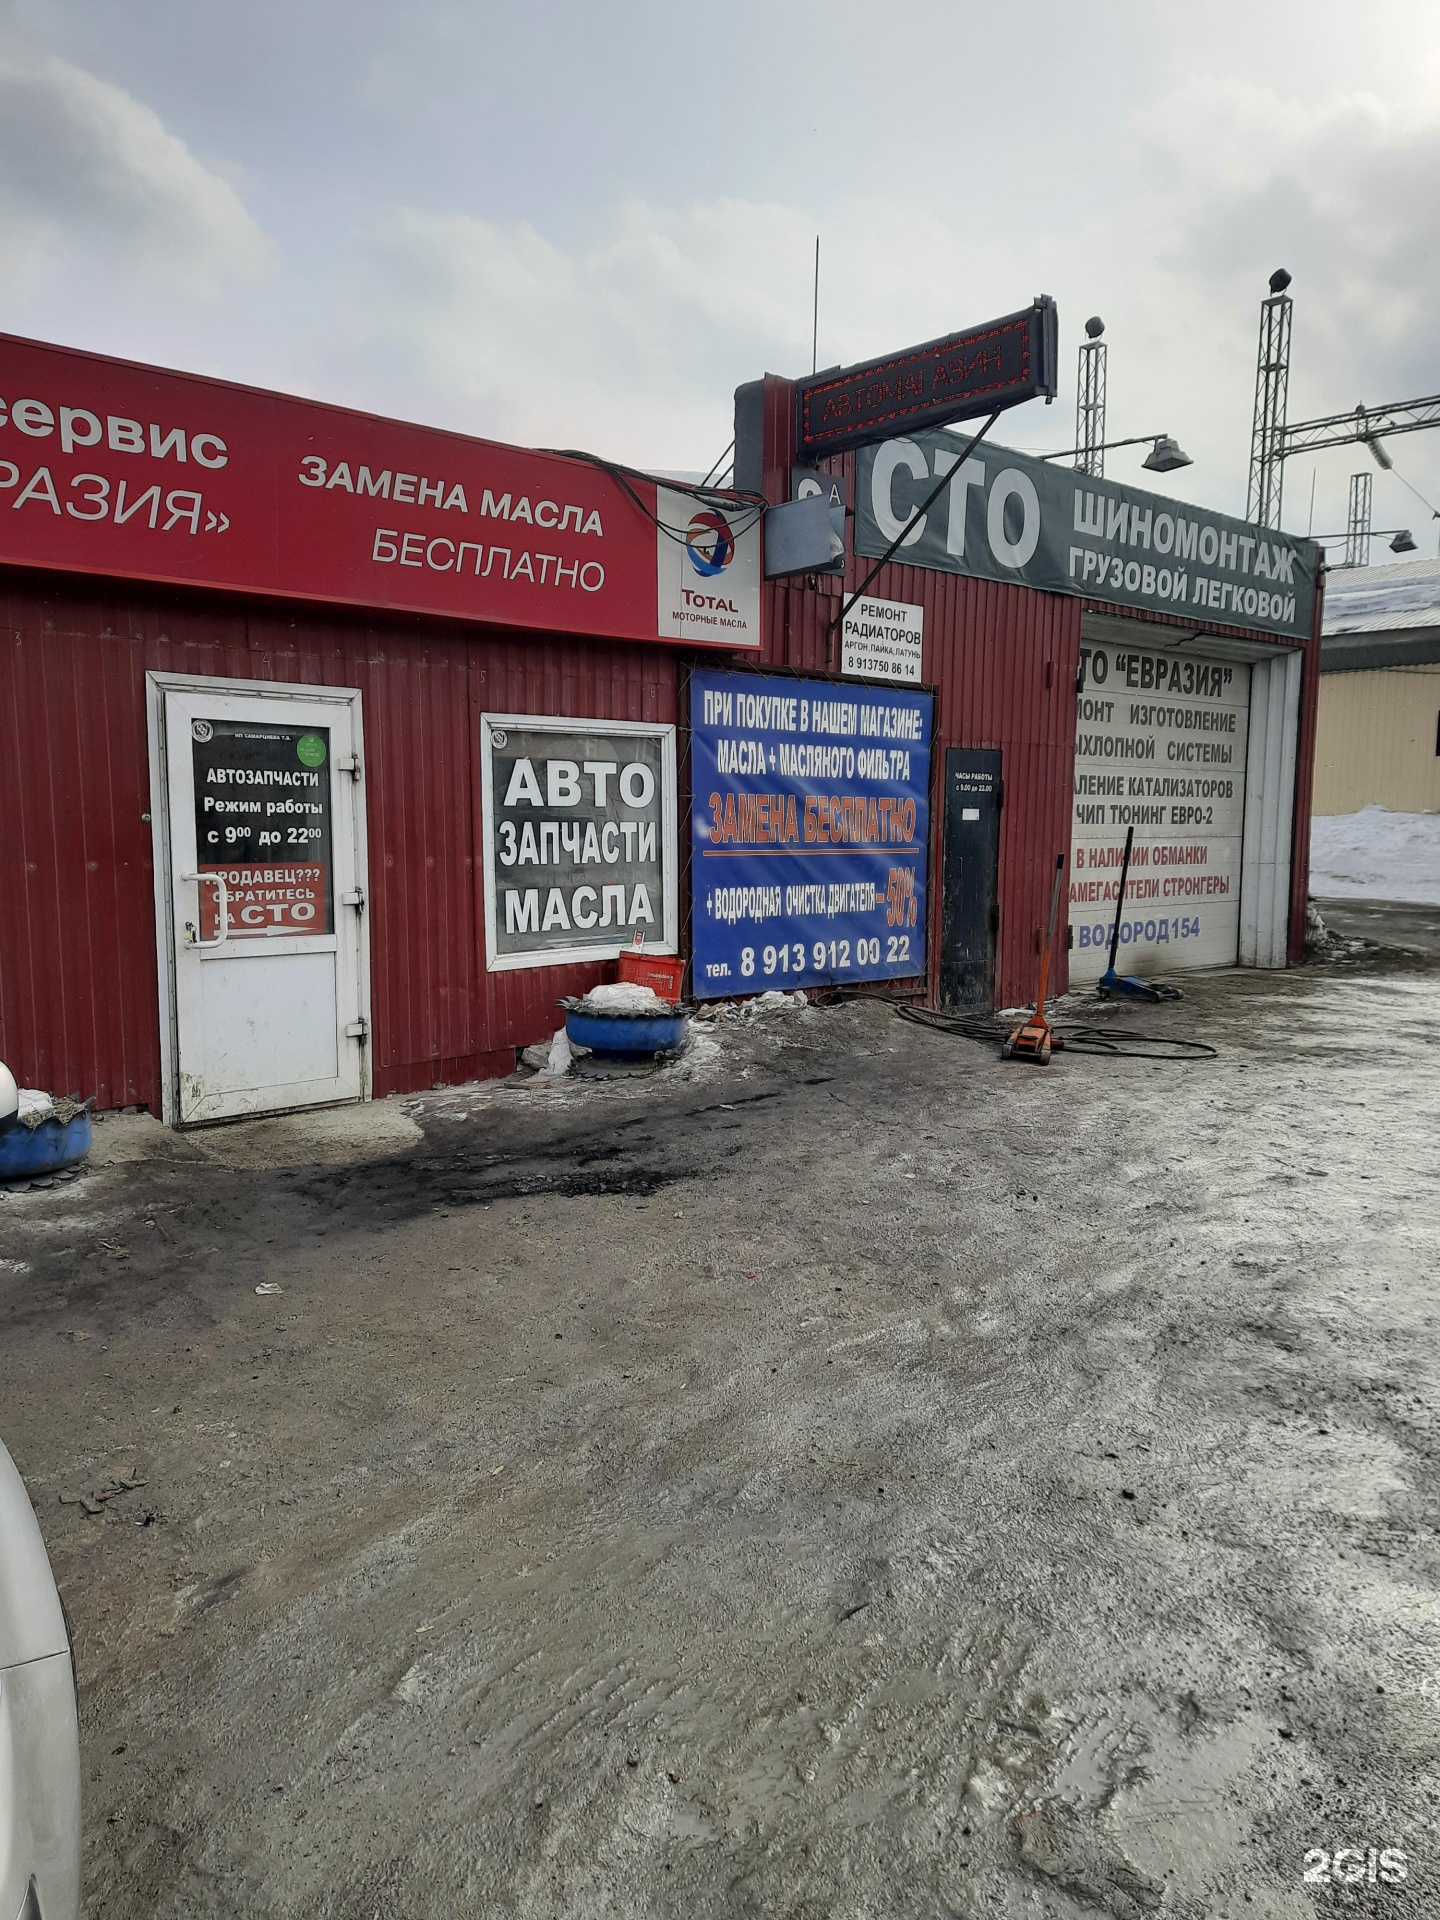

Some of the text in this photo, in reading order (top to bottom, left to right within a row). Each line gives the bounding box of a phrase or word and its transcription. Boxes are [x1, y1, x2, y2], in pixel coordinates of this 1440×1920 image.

[0, 396, 229, 470] ервис
[298, 455, 604, 537] ЗАМЕНА МАСЛА
[871, 437, 1041, 569] СТО
[1073, 488, 1297, 585] ШИНОМОНТАЖ
[372, 528, 606, 592] БЕСПЛАТНО
[1069, 545, 1296, 624] ГРУЗОВОЙ ЛЕГКОВОЙ
[682, 589, 739, 613] TOTAL
[861, 603, 908, 623] РЕМОНТ
[672, 611, 748, 630] МОТОРНЫЕ МАСЛА
[845, 620, 921, 645] РАДИАТОРОВ
[848, 655, 915, 676] 8 913750 86 14
[704, 690, 923, 740] ПРИ ПОКУПКЕ В НАШЕМ МАГАЗИНЕ:
[1130, 703, 1237, 733] ИЗГОТОВЛЕНИЕ
[717, 739, 911, 781] МАСЛА + МАСЛЯНОГО ФИЛЬТРА
[1167, 740, 1232, 764] СИСТЕМЫ
[207, 768, 320, 788] АВТОЗАПЧАСТИ
[503, 758, 655, 809] АВТО
[955, 772, 993, 781] ЧАСЫ РАБОТЫ
[1128, 777, 1233, 799] КАТАЛИЗАТОРОВ
[204, 797, 323, 816] Режим работы
[708, 792, 917, 844] ЗАМЕНА БЕСПЛАТНО
[1076, 804, 1214, 825] ЧИП ТЮНИНГ ЕВРО-2
[258, 829, 282, 846] до
[499, 821, 656, 866] ЗАПЧАСТИ
[1076, 846, 1208, 869] В НАЛИИИ ОБМАНКИ
[1163, 875, 1230, 897] СТРОНГЕРЫ
[241, 902, 316, 924] СТО
[505, 883, 655, 935] МАСЛА
[715, 885, 782, 925] ВОДОРОДНАЯ
[786, 883, 827, 917] ОЧИСТКА
[827, 881, 876, 919] ДВИГАТЕЛЯ
[706, 935, 911, 978] тел. 8 913 912 00 22
